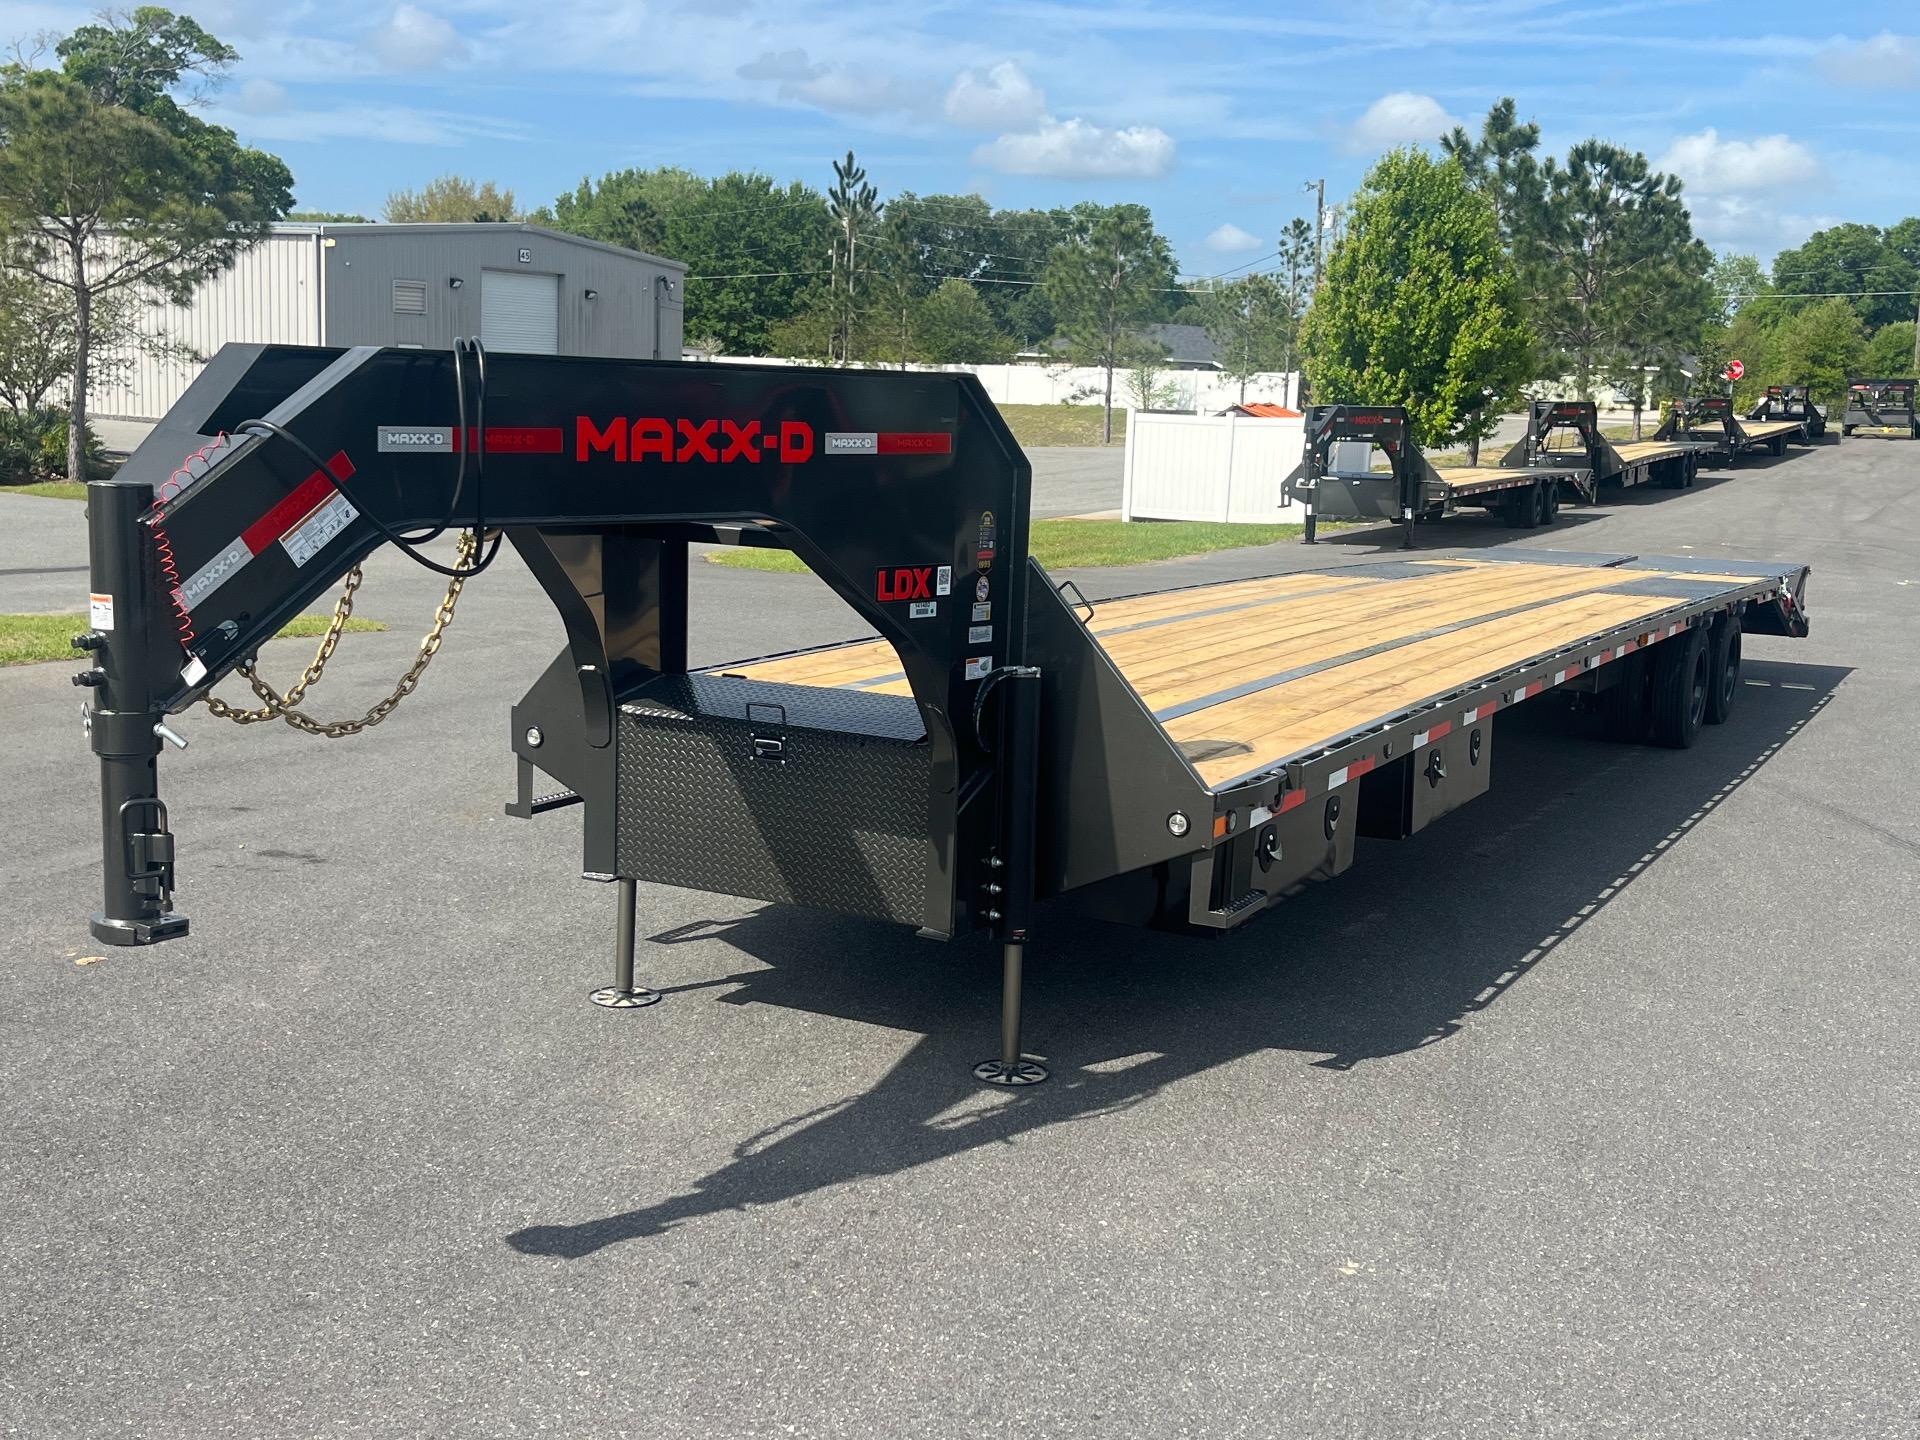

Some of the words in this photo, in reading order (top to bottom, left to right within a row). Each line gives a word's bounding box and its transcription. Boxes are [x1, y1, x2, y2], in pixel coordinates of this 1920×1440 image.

[520, 251, 530, 261] 45
[387, 433, 444, 445] MAXX-D
[576, 416, 814, 463] MAXX-D
[831, 438, 872, 448] MAXX-D
[185, 550, 241, 600] MAXX-D
[877, 568, 932, 602] LDX
